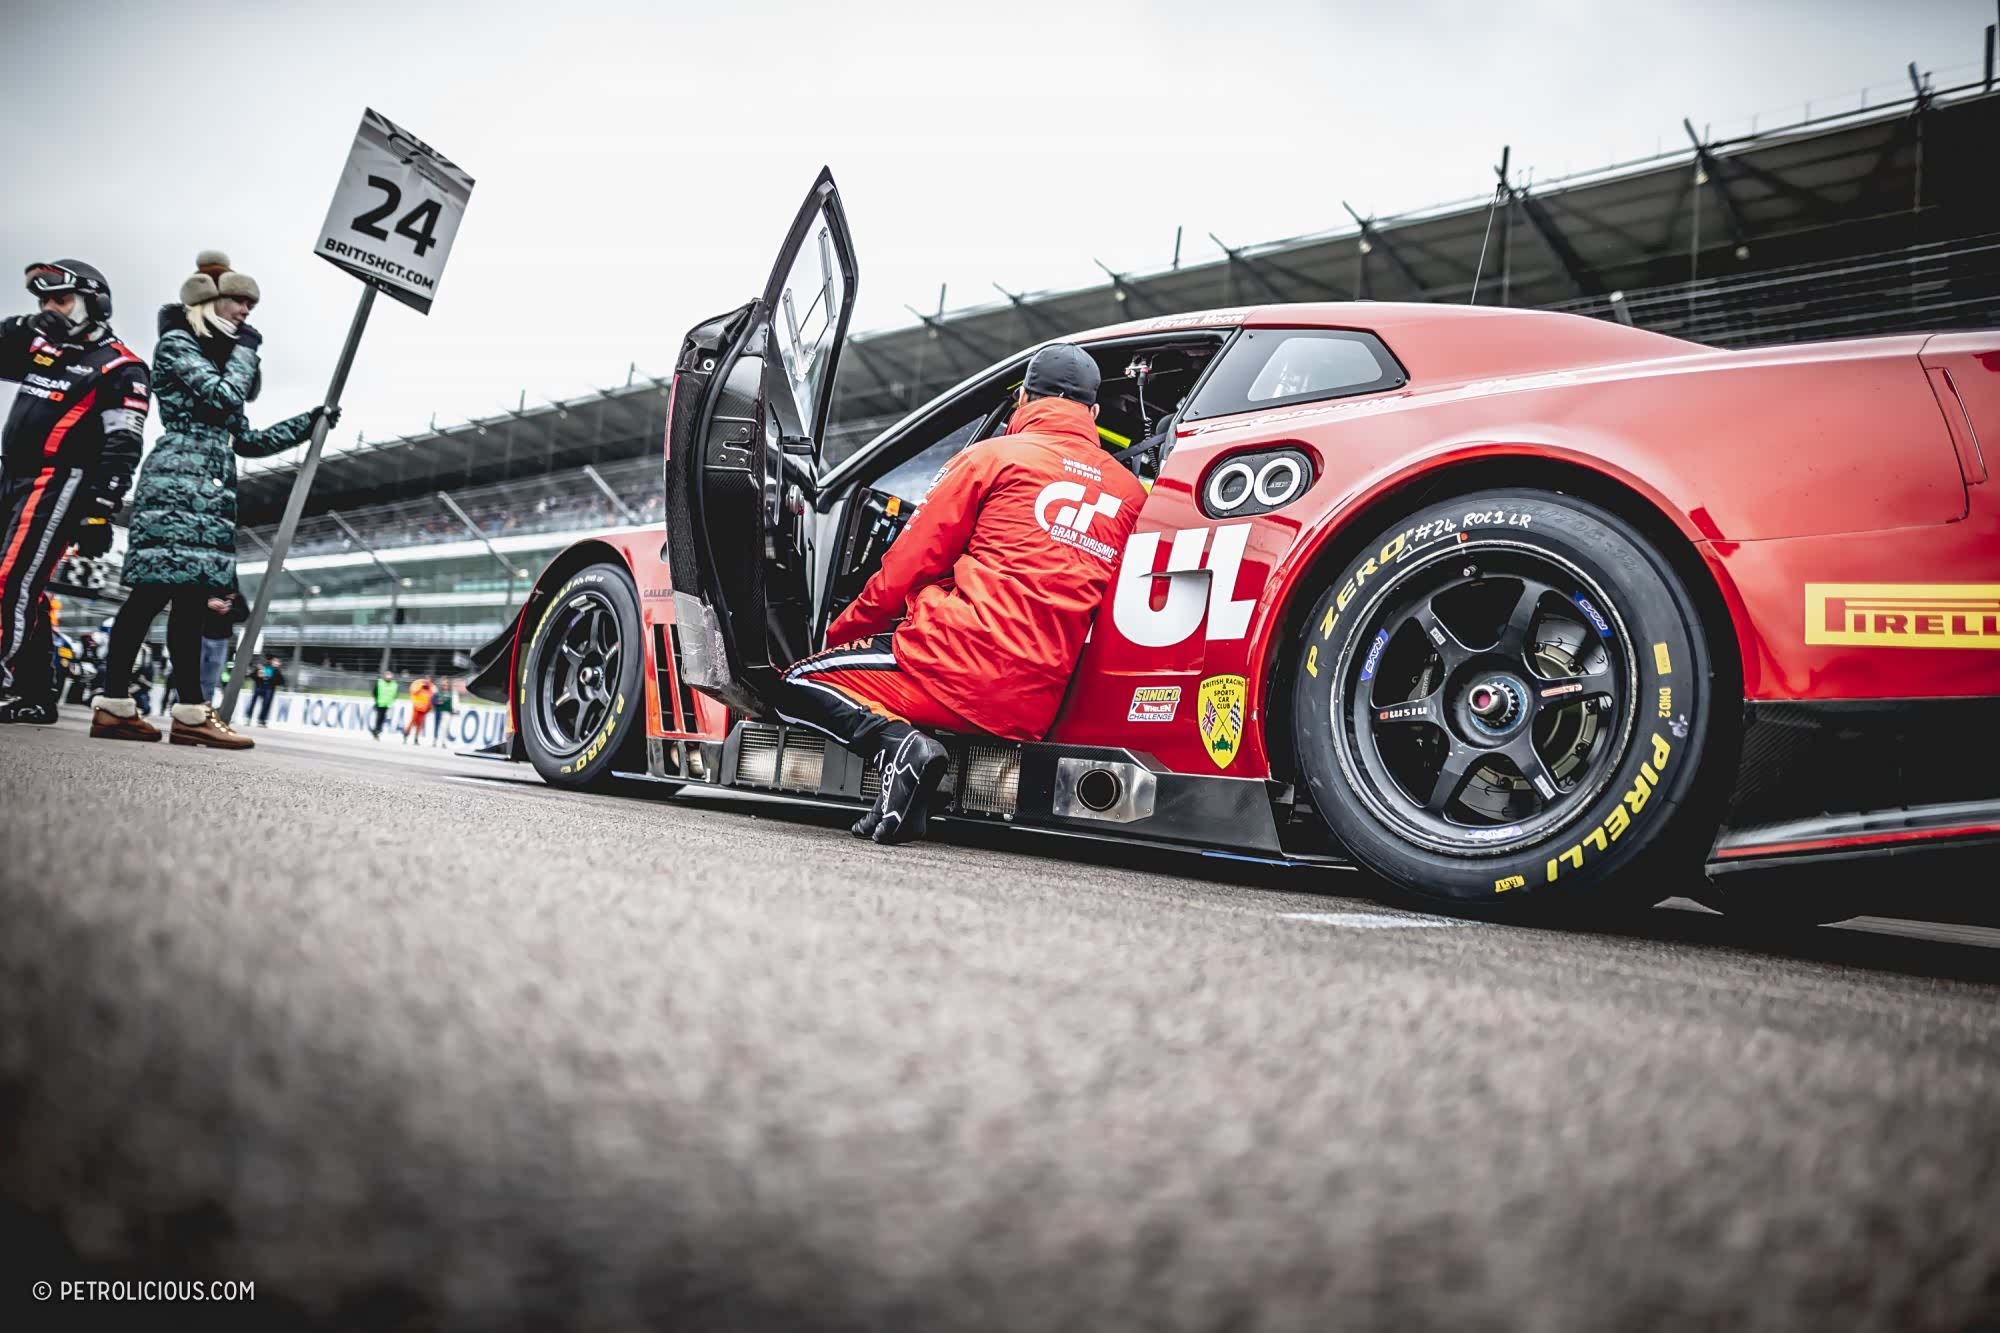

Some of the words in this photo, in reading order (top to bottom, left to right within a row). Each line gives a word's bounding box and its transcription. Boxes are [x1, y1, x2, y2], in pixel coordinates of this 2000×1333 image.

[351, 174, 443, 258] 24
[324, 237, 434, 291] BRITISHGT.COM
[1062, 458, 1102, 476] NISSAN
[1064, 465, 1102, 482] nismo
[1050, 525, 1078, 541] GRAN
[1079, 534, 1116, 558] TURISMO
[1415, 519, 1457, 542] #24
[1508, 513, 1532, 528] LR
[1085, 522, 1257, 647] UL
[1306, 645, 1319, 678] P
[1320, 533, 1405, 641] ZERO
[1579, 600, 1608, 631] RAYS
[1365, 636, 1384, 674] RAYS
[1135, 688, 1179, 702] SUNOCO
[1203, 679, 1223, 689] BRITISH
[1225, 678, 1244, 688] RACING
[1380, 706, 1428, 720] nismo
[1658, 688, 1672, 718] DHD2
[576, 714, 616, 772] ZERO
[1547, 733, 1671, 883] PIRELLI
